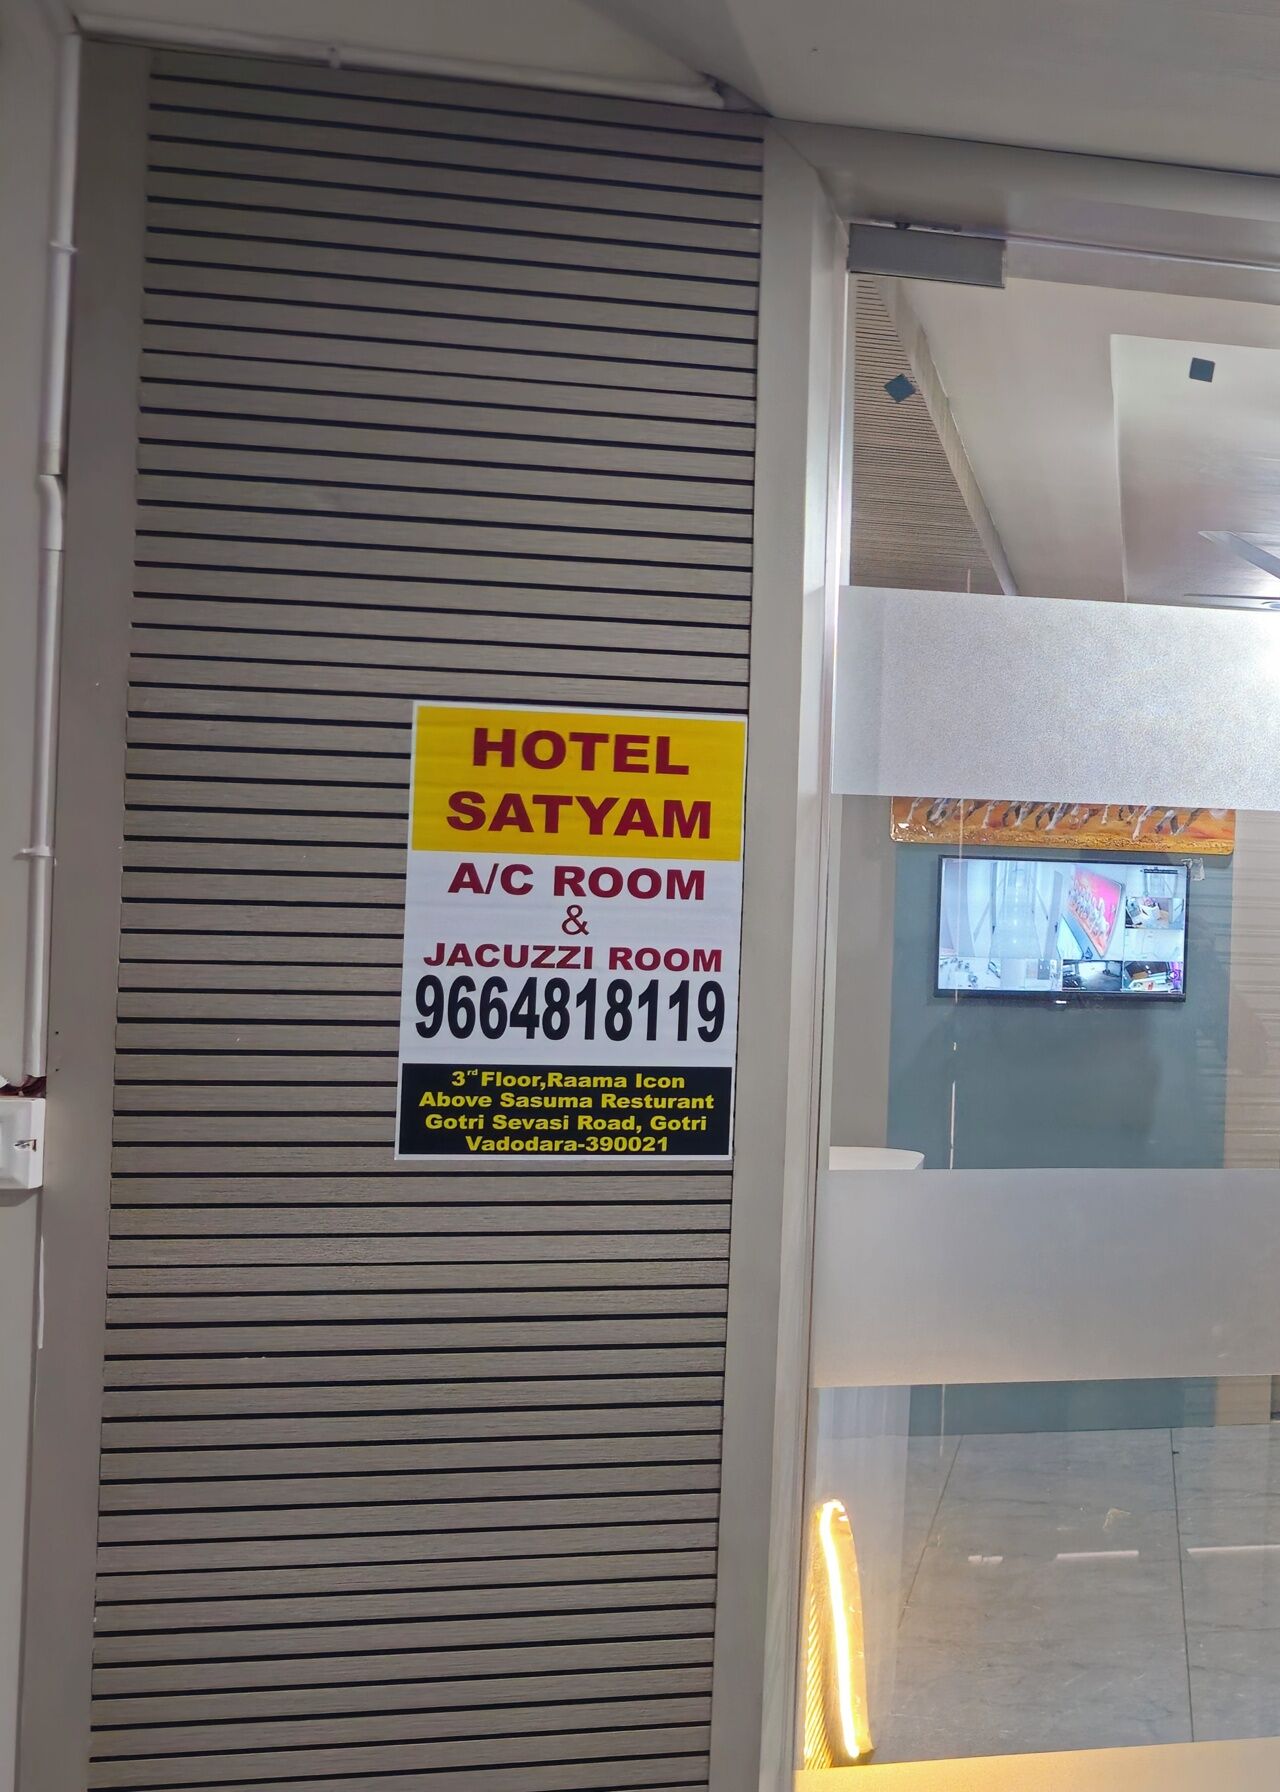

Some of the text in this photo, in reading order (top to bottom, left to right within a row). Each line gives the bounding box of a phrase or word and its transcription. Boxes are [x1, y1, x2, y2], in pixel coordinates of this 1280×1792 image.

[472, 727, 690, 776] HOTEL
[446, 791, 712, 839] SATYAM
[448, 862, 706, 900] A/C ROOM
[561, 904, 590, 936] &
[423, 942, 723, 973] JACUZZI ROOM
[415, 974, 725, 1043] 9664818119
[635, 1073, 685, 1088] Icon
[419, 1091, 715, 1109] Above Sasuma Resturant
[425, 1113, 707, 1134] Gotri Sevasi Road, Gotri
[465, 1135, 668, 1152] Vadodara-390021
